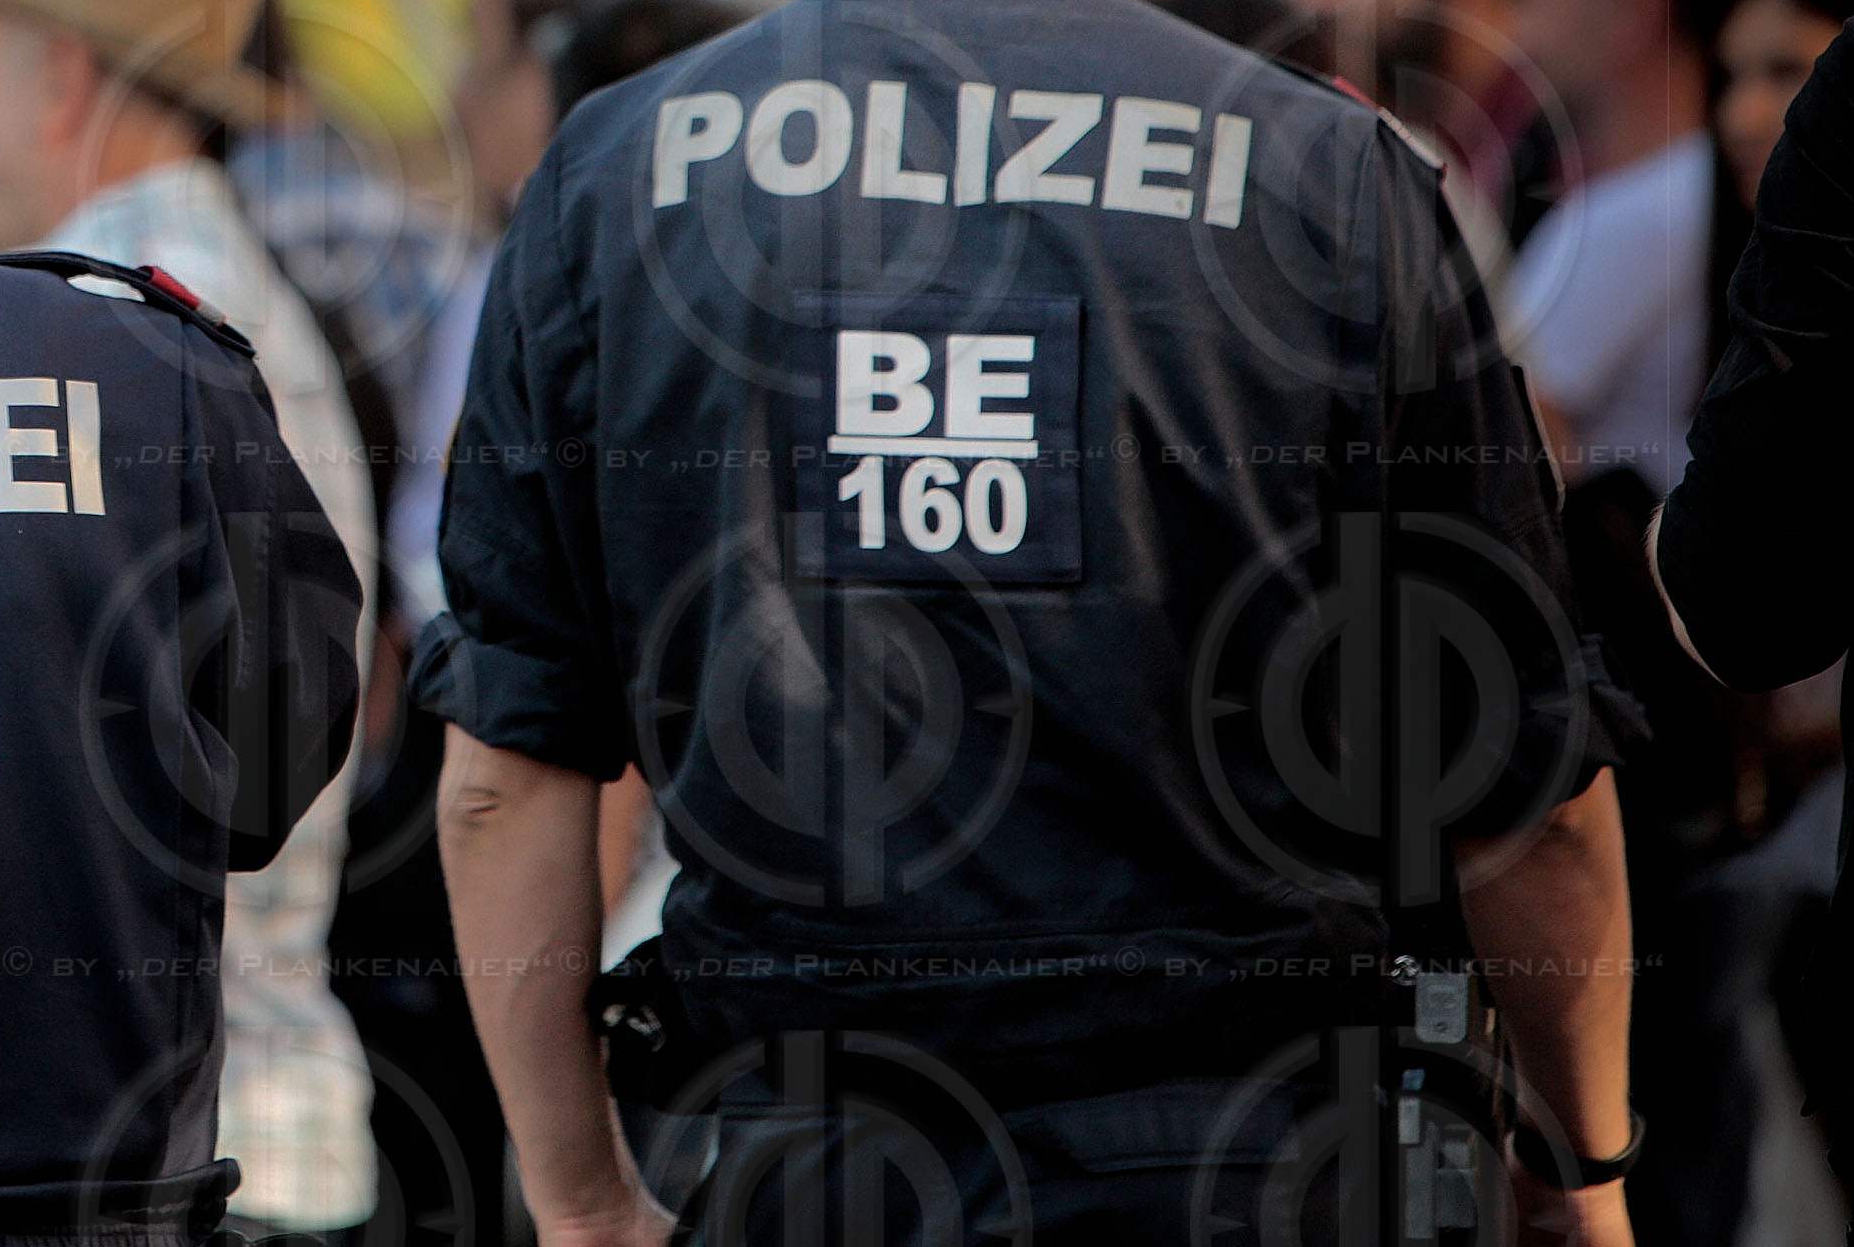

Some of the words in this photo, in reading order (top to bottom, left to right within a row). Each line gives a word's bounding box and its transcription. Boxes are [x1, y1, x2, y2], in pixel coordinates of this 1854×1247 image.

[651, 79, 1253, 229] POLIZEI
[835, 329, 1035, 440] BE
[837, 455, 1028, 555] 160
